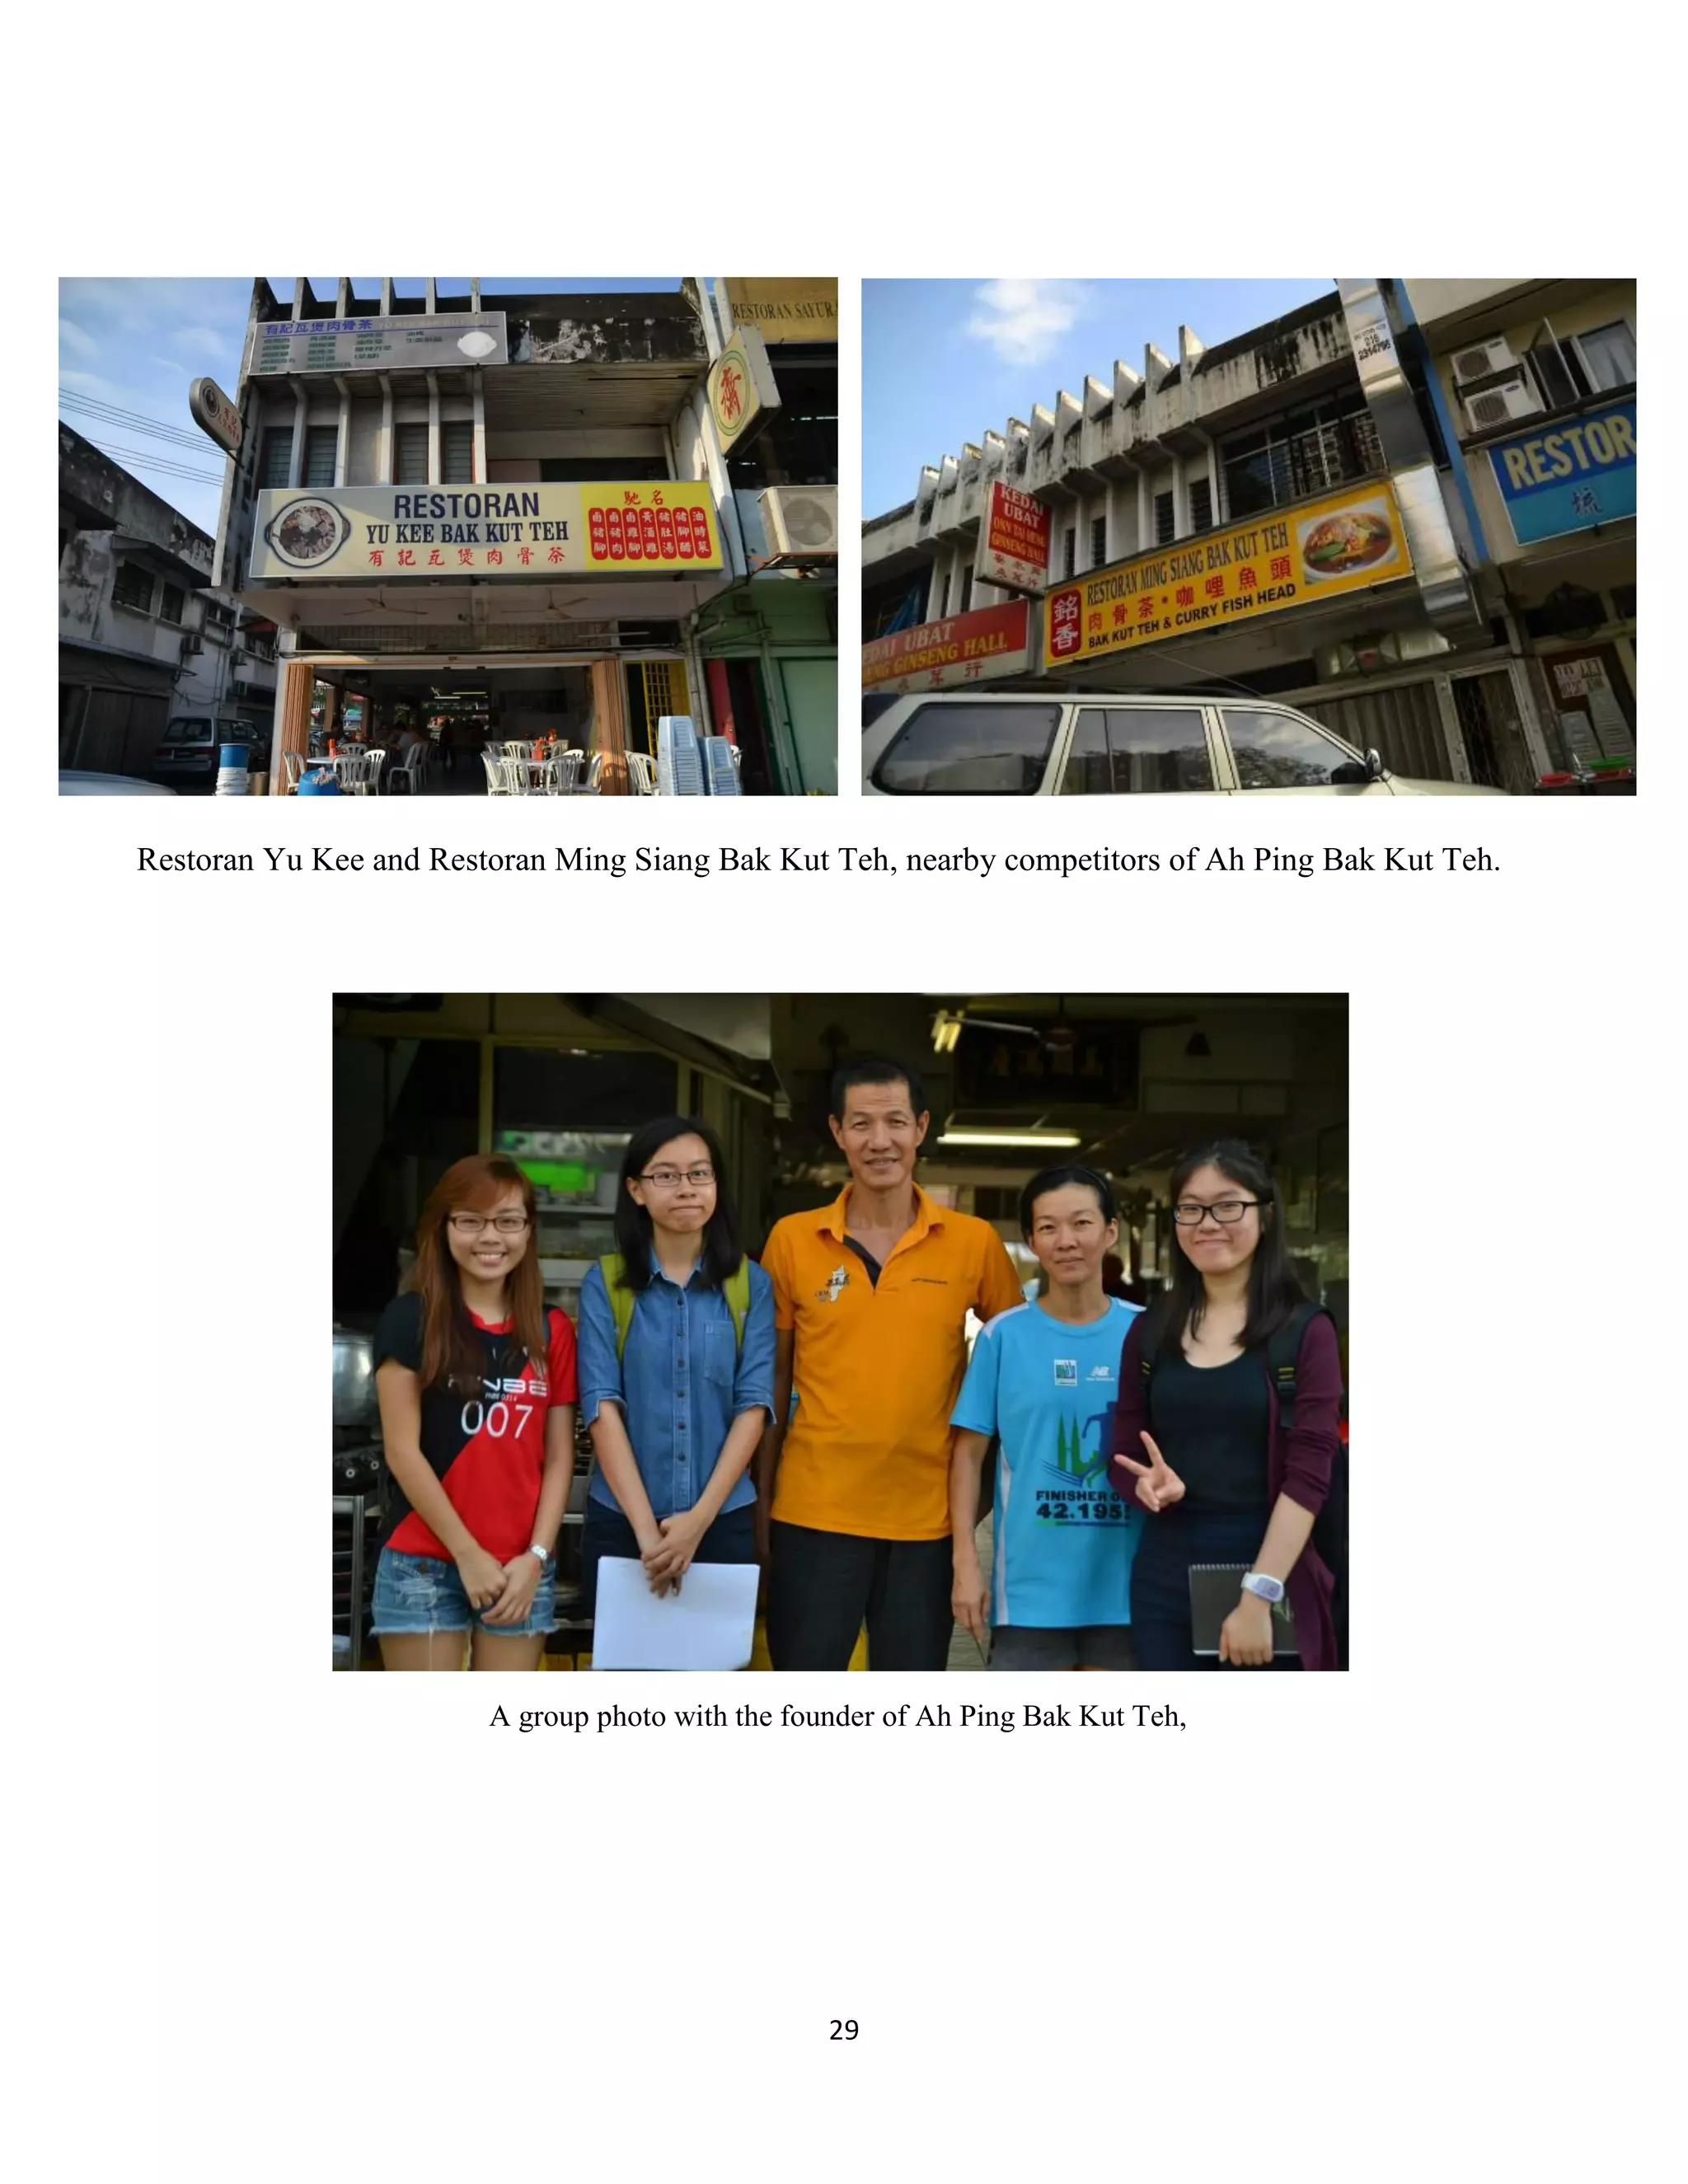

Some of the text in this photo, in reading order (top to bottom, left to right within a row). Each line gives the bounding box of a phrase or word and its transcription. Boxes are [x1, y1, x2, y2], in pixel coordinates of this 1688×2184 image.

[732, 302, 791, 319] RESTORAN
[1503, 415, 1636, 490] RESTOR
[394, 492, 540, 518] RESTORAN
[624, 490, 664, 505] 馳名
[1001, 485, 1044, 516] KEDAI
[1004, 501, 1040, 528] UBAT
[366, 521, 570, 544] YU KEE BAK KUT TEH
[368, 546, 565, 567] 有記瓦煲肉骨茶
[1087, 522, 1289, 606] RESTORAN MING SIANG BAK KUT TEH
[1052, 595, 1079, 650] 銘香
[1089, 583, 1296, 649] BAK KUT TEH & CURRY FISH HEAD
[905, 622, 955, 650] UBAT
[893, 642, 959, 674] GINSENG
[964, 631, 1008, 658] HALL
[462, 1400, 533, 1439] 007
[1036, 1490, 1107, 1502] FINISHER
